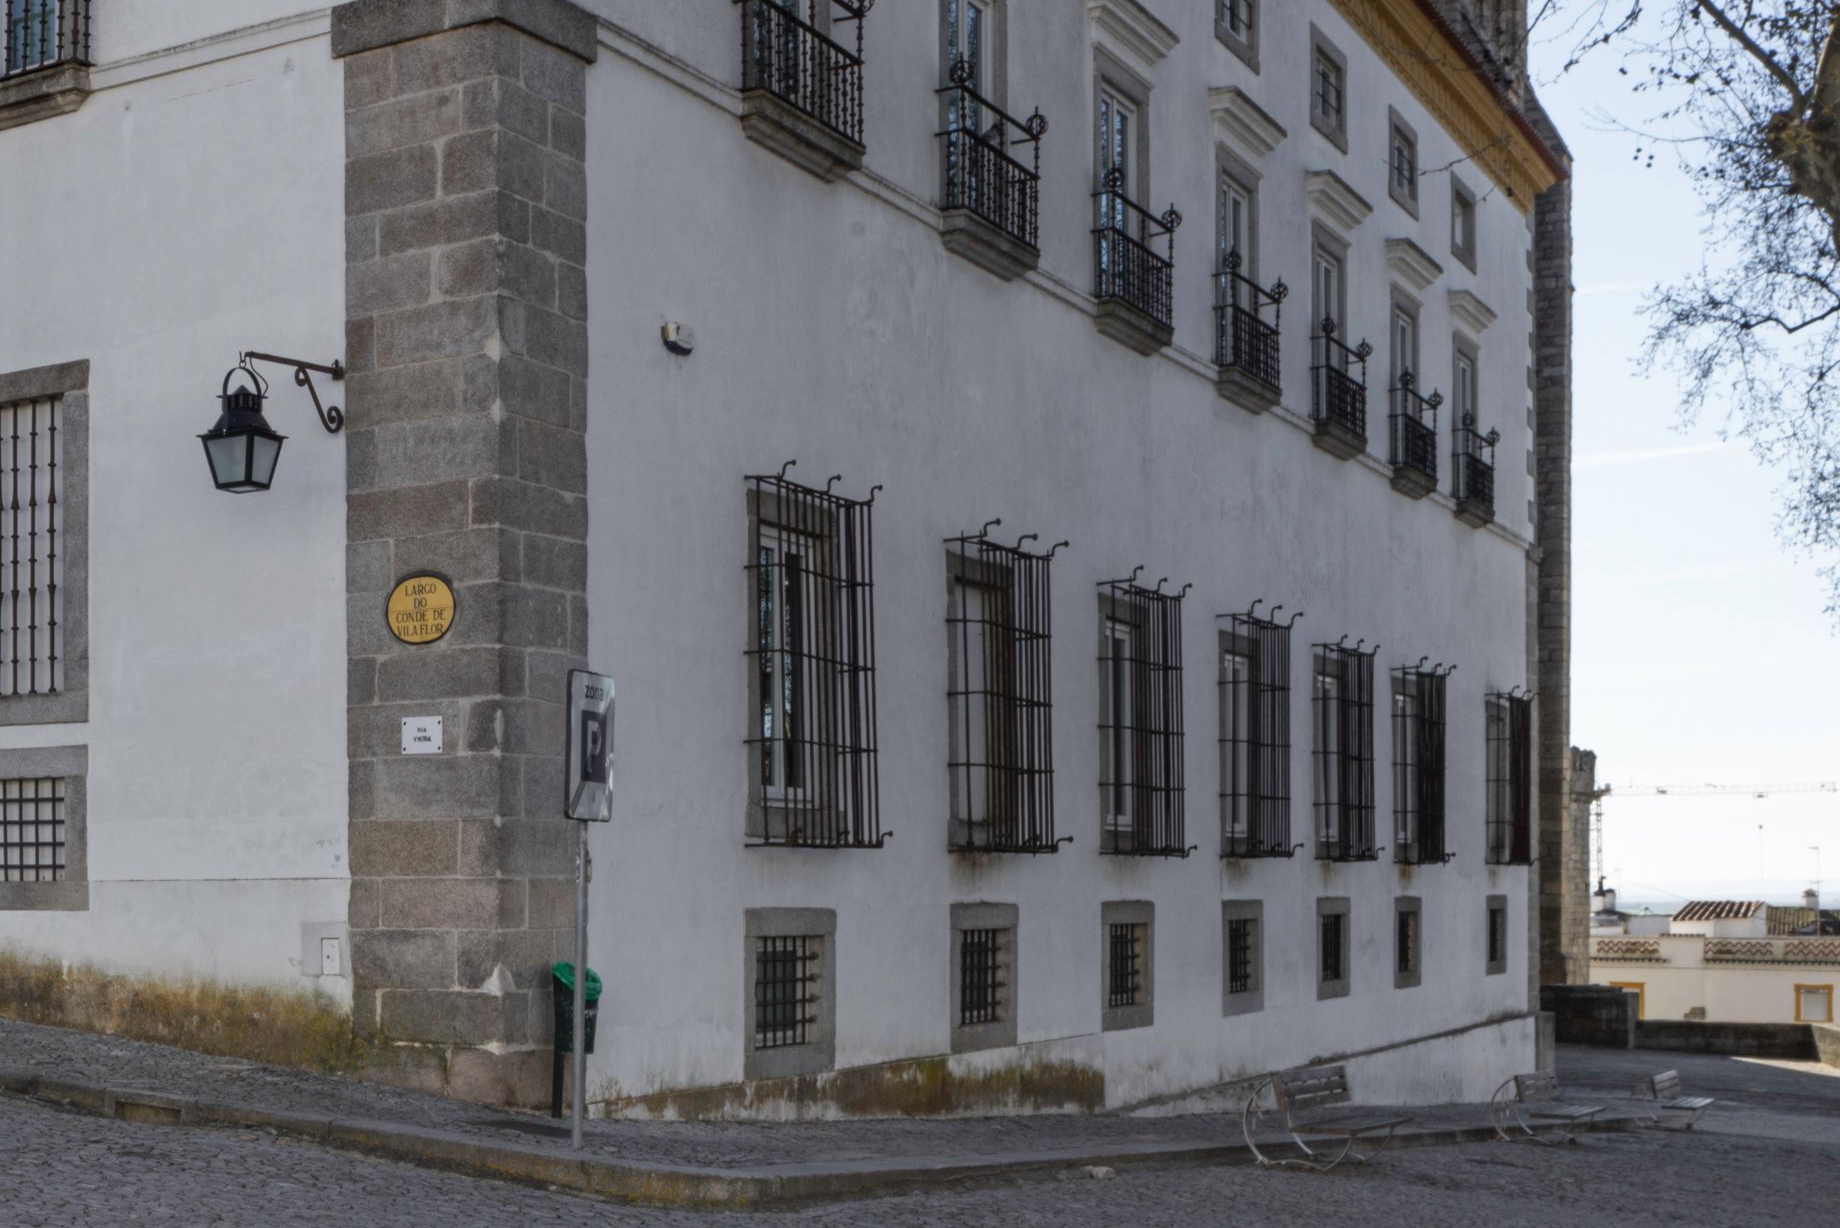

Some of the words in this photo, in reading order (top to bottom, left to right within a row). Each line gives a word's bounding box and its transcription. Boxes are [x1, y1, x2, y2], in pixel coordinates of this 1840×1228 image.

[413, 597, 428, 609] DO
[396, 610, 429, 623] CONDE
[433, 608, 447, 621] DE
[396, 625, 418, 637] VILA
[420, 622, 444, 636] FLOR
[585, 684, 604, 701] zona
[587, 720, 602, 773] P
